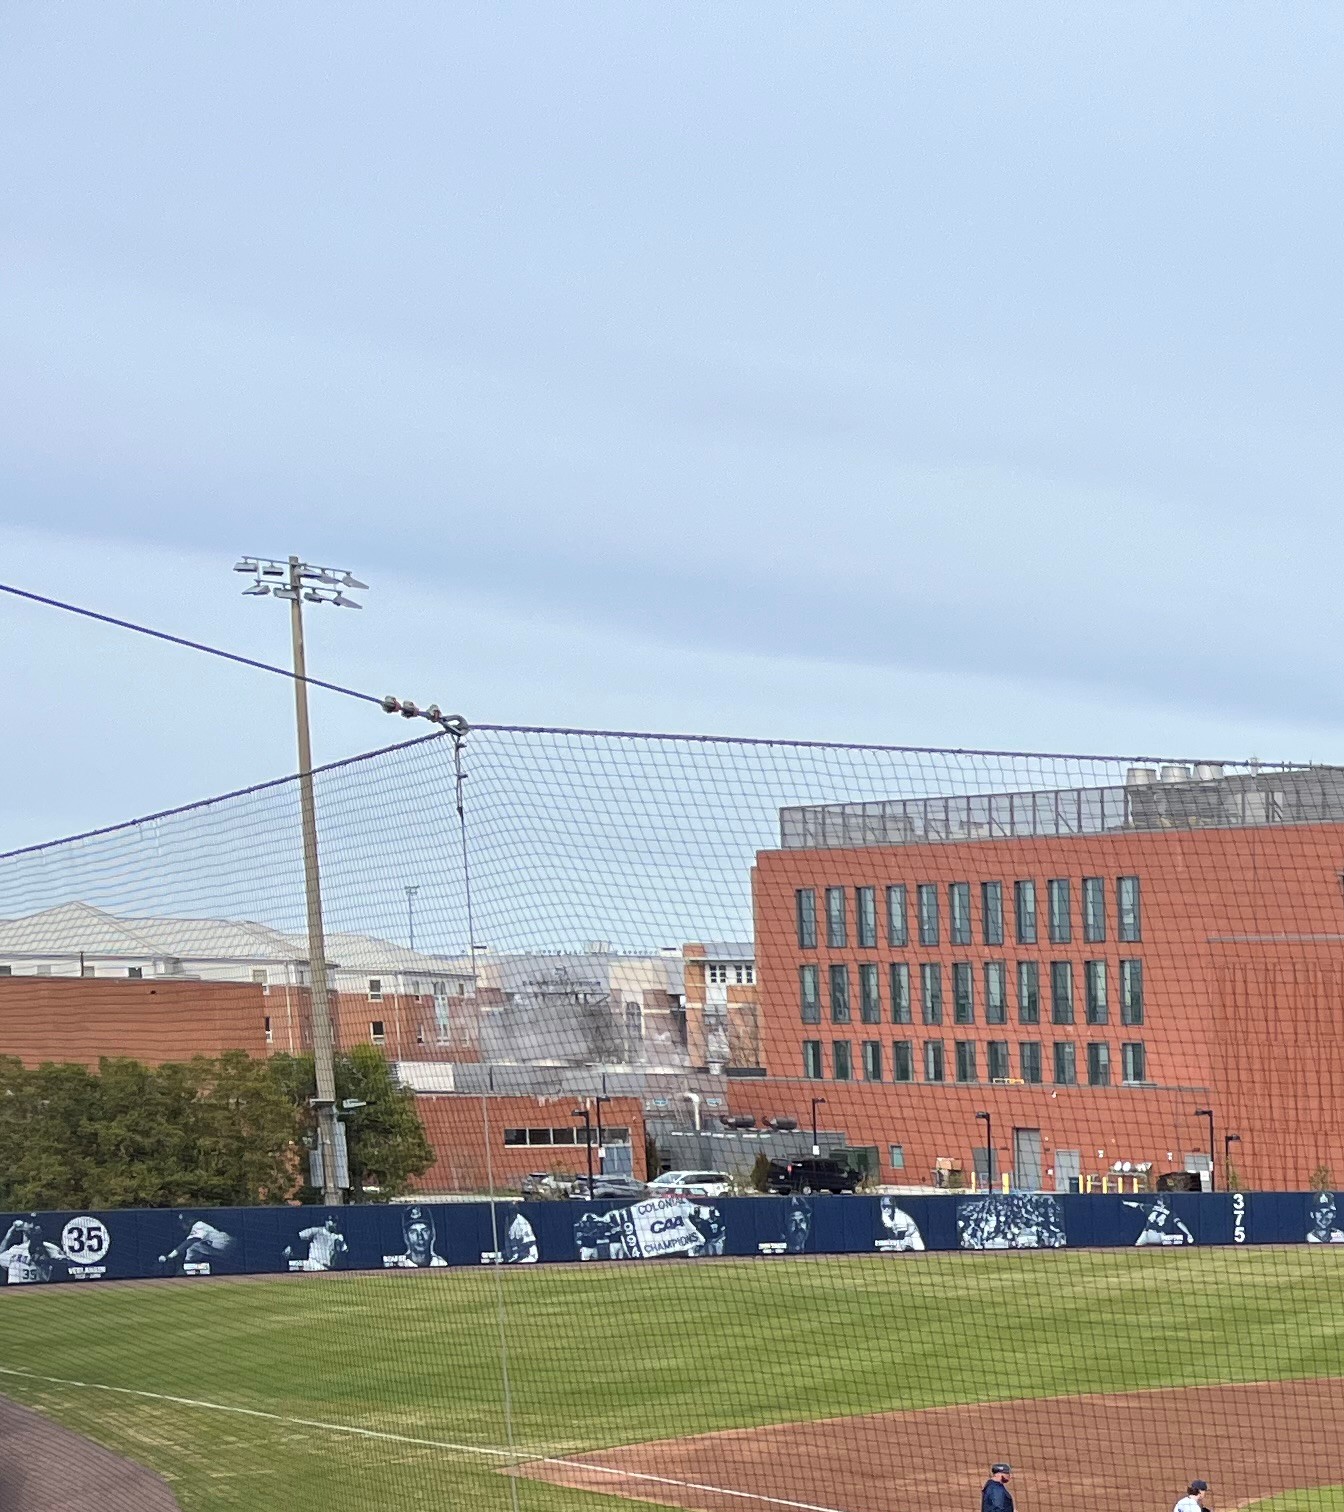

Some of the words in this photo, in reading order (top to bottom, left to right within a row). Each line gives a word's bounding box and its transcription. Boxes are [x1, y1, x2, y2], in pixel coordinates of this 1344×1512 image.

[650, 1216, 685, 1234] CAA
[1233, 1193, 1246, 1243] 375
[67, 1226, 104, 1254] 35
[643, 1232, 699, 1254] CHAMPIONS
